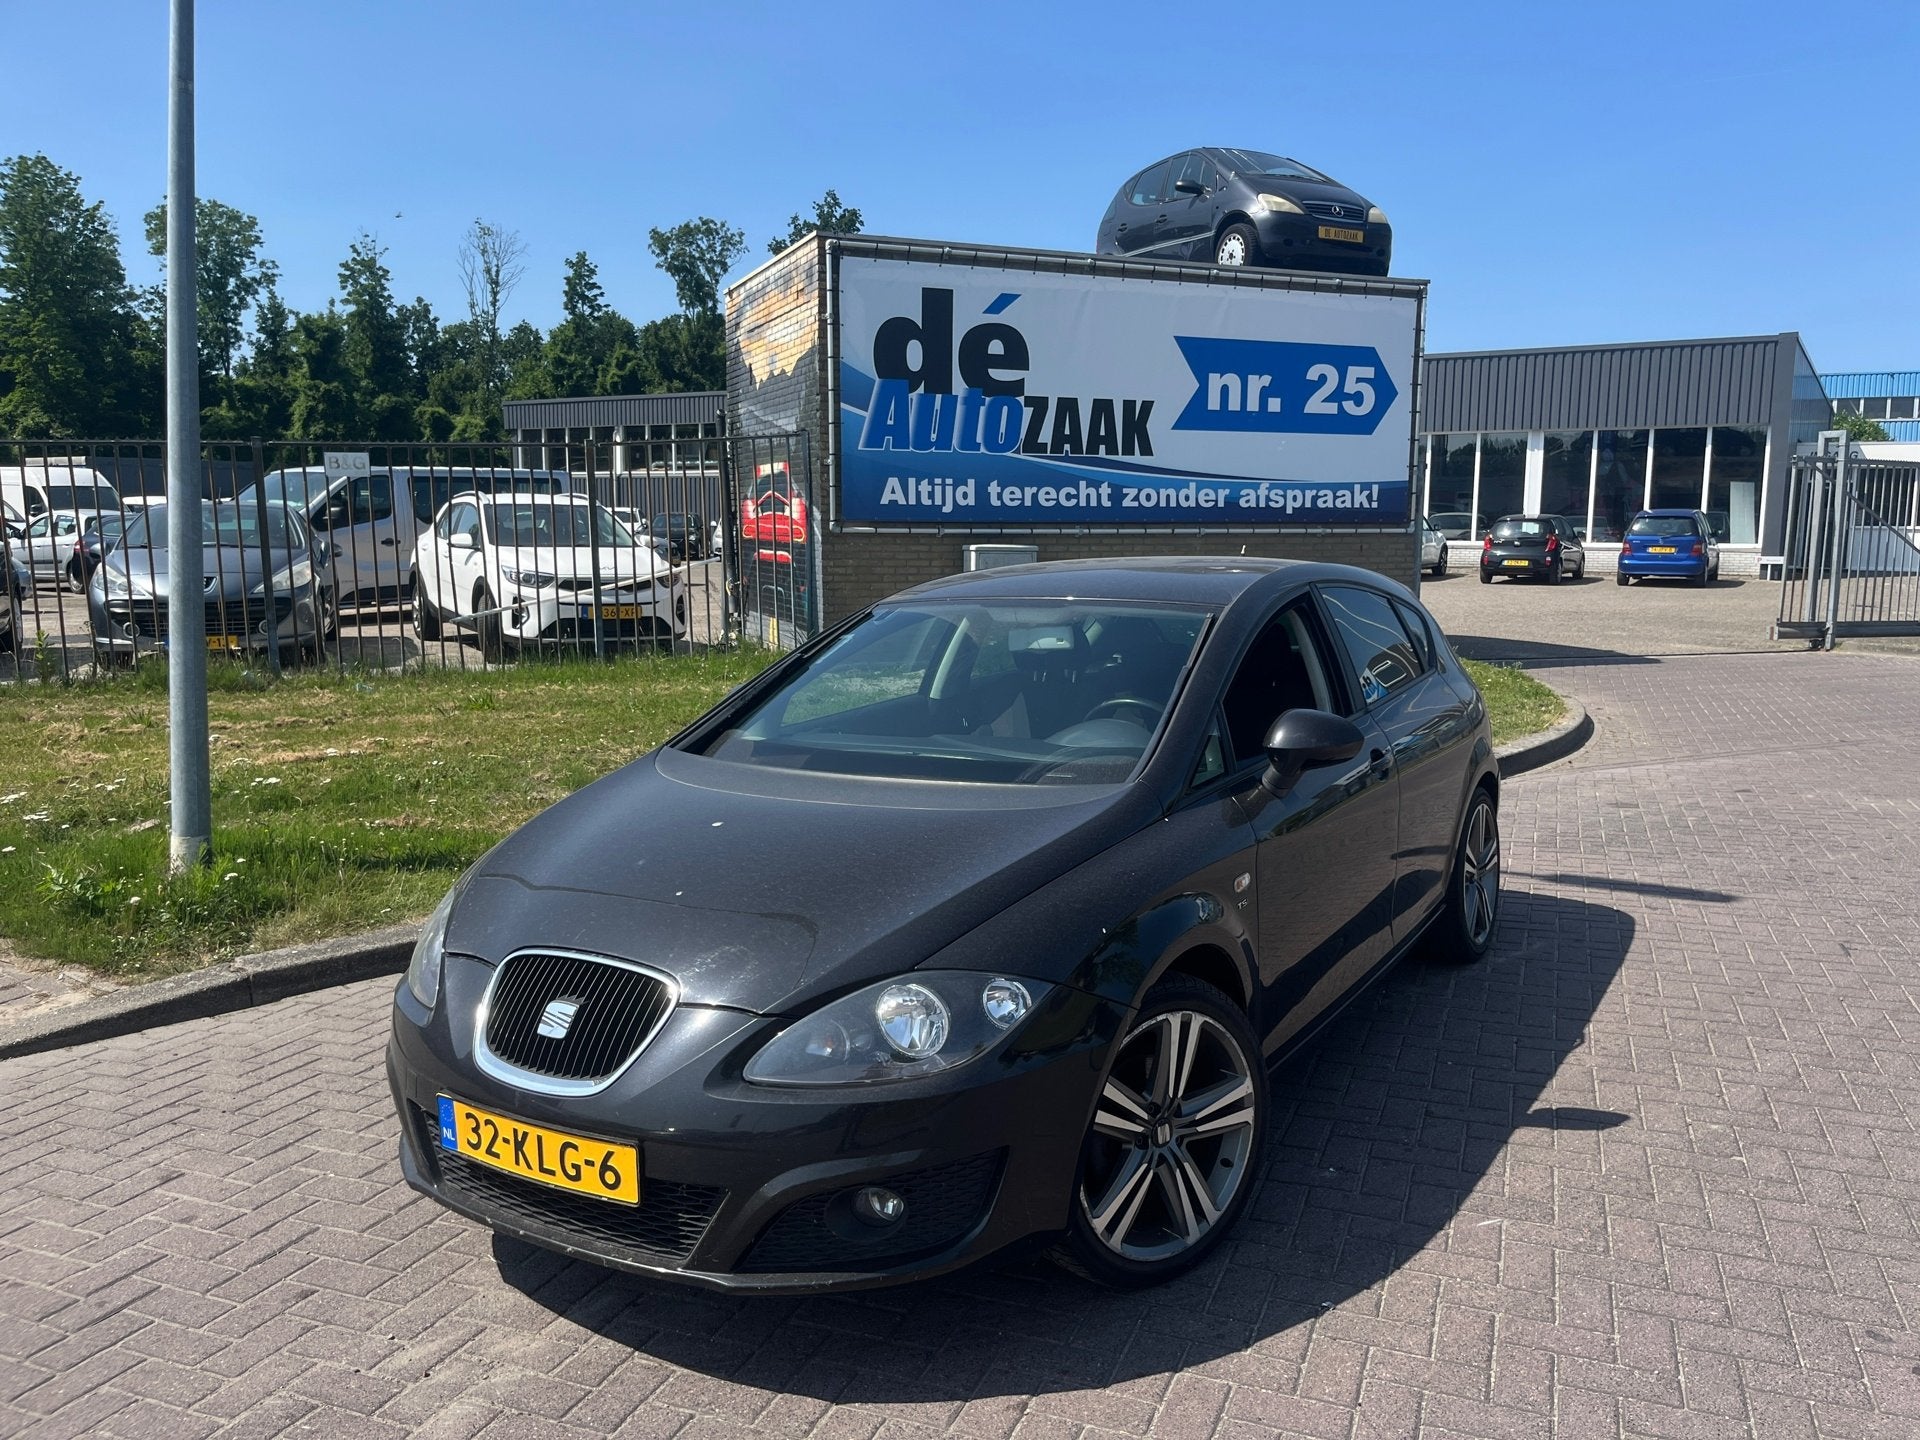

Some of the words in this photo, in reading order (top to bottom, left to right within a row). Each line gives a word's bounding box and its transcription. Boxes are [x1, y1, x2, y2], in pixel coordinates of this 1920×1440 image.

[1334, 229, 1359, 240] AUTOZAAK
[873, 287, 1030, 398] dé
[1207, 372, 1281, 413] nr.
[1303, 363, 1376, 416] 25
[328, 454, 366, 470] B&G
[880, 477, 975, 513] Altijd
[988, 479, 1112, 507] terecht
[1122, 482, 1230, 508] zonder
[1239, 482, 1379, 514] afspraak!
[443, 1127, 456, 1141] NL
[465, 1112, 622, 1191] 32-KLG-6
